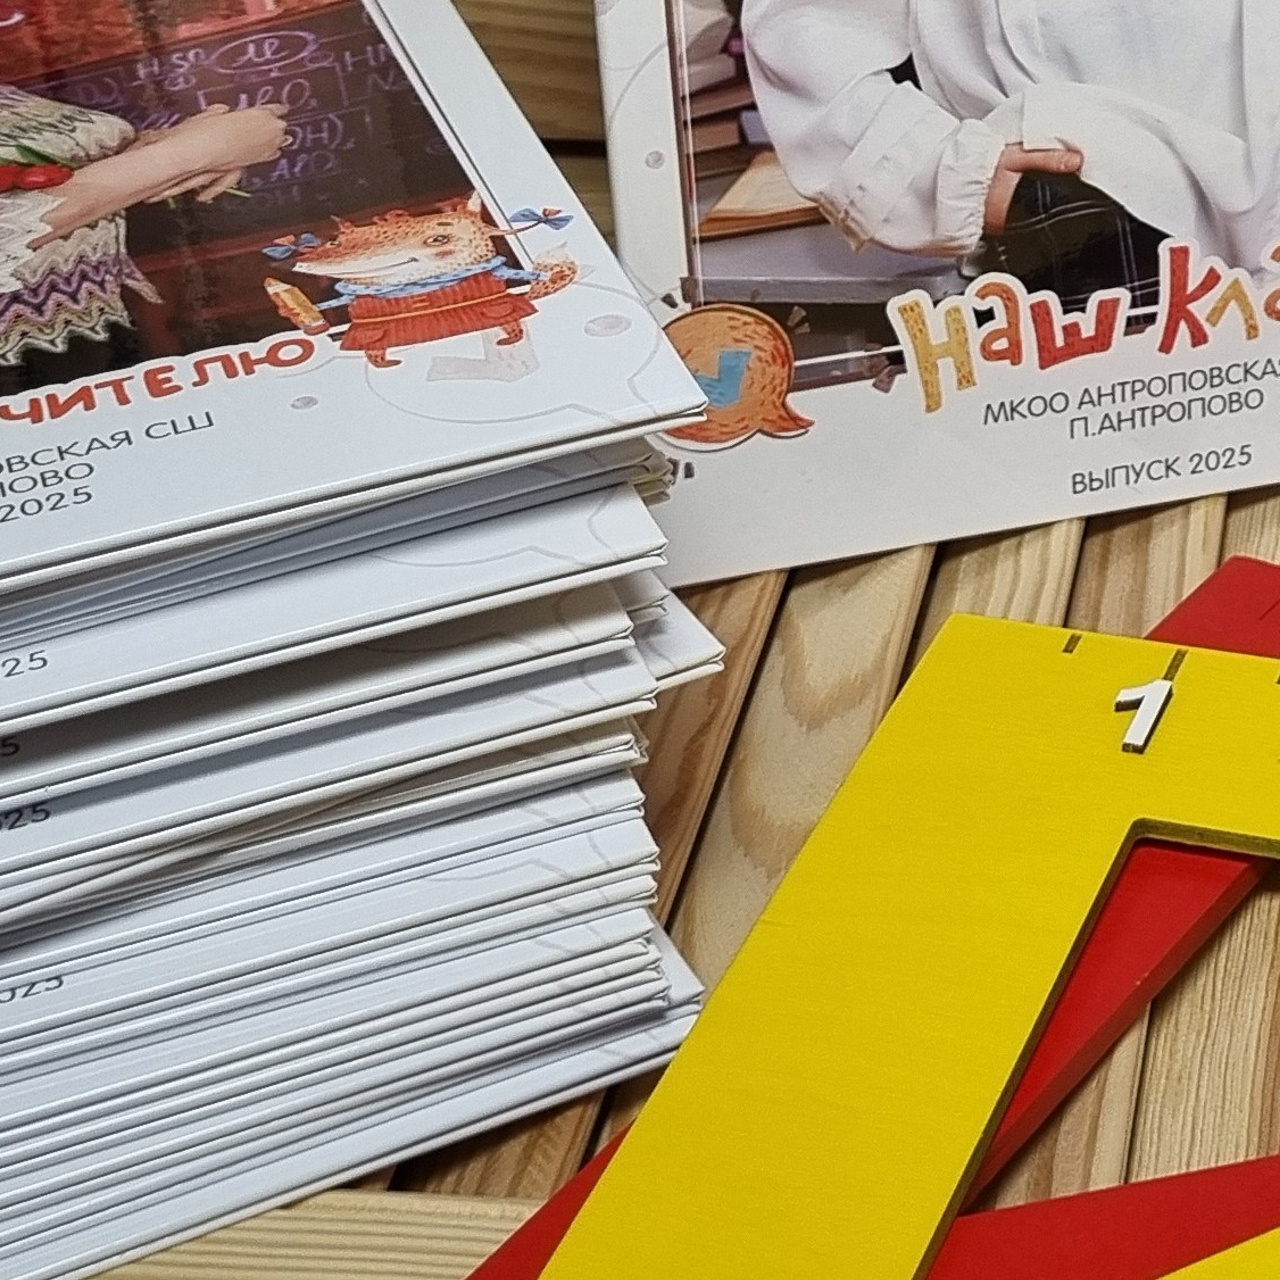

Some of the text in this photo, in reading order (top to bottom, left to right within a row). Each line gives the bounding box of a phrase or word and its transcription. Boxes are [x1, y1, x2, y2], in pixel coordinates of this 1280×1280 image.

[983, 390, 1070, 426] МКОО
[1069, 388, 1264, 439] П.АНТРОПОВО
[0, 411, 215, 474] ВСКАЯ СШ
[1071, 445, 1253, 495] ВЫПУСК 2025
[0, 486, 93, 520] 2025
[1114, 679, 1174, 755] 1
[0, 800, 51, 831] 25
